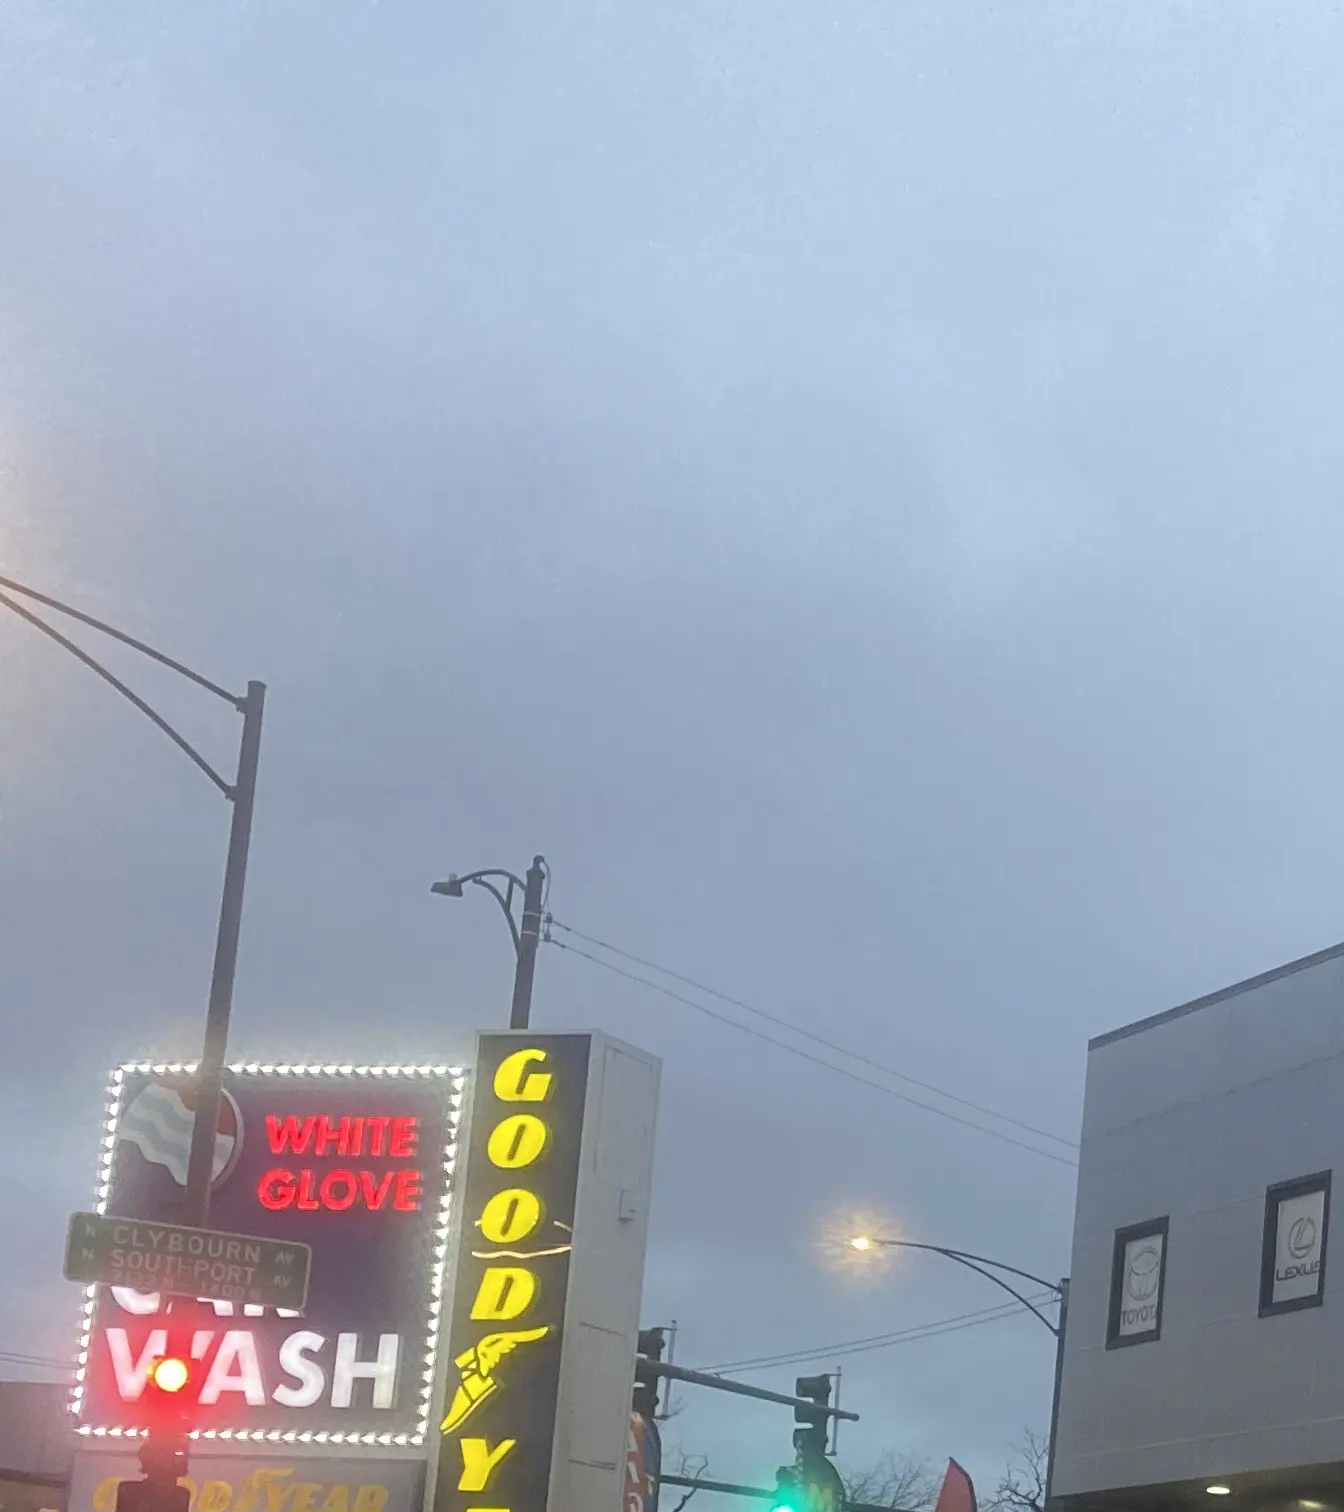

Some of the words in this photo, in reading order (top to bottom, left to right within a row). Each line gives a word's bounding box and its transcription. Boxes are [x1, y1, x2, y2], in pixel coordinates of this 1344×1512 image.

[265, 1114, 419, 1157] WHITE
[257, 1168, 426, 1211] GLOVE
[113, 1225, 261, 1264] CLYBOURN
[110, 1248, 258, 1286] SOUTHPORT
[105, 1327, 400, 1410] WASH
